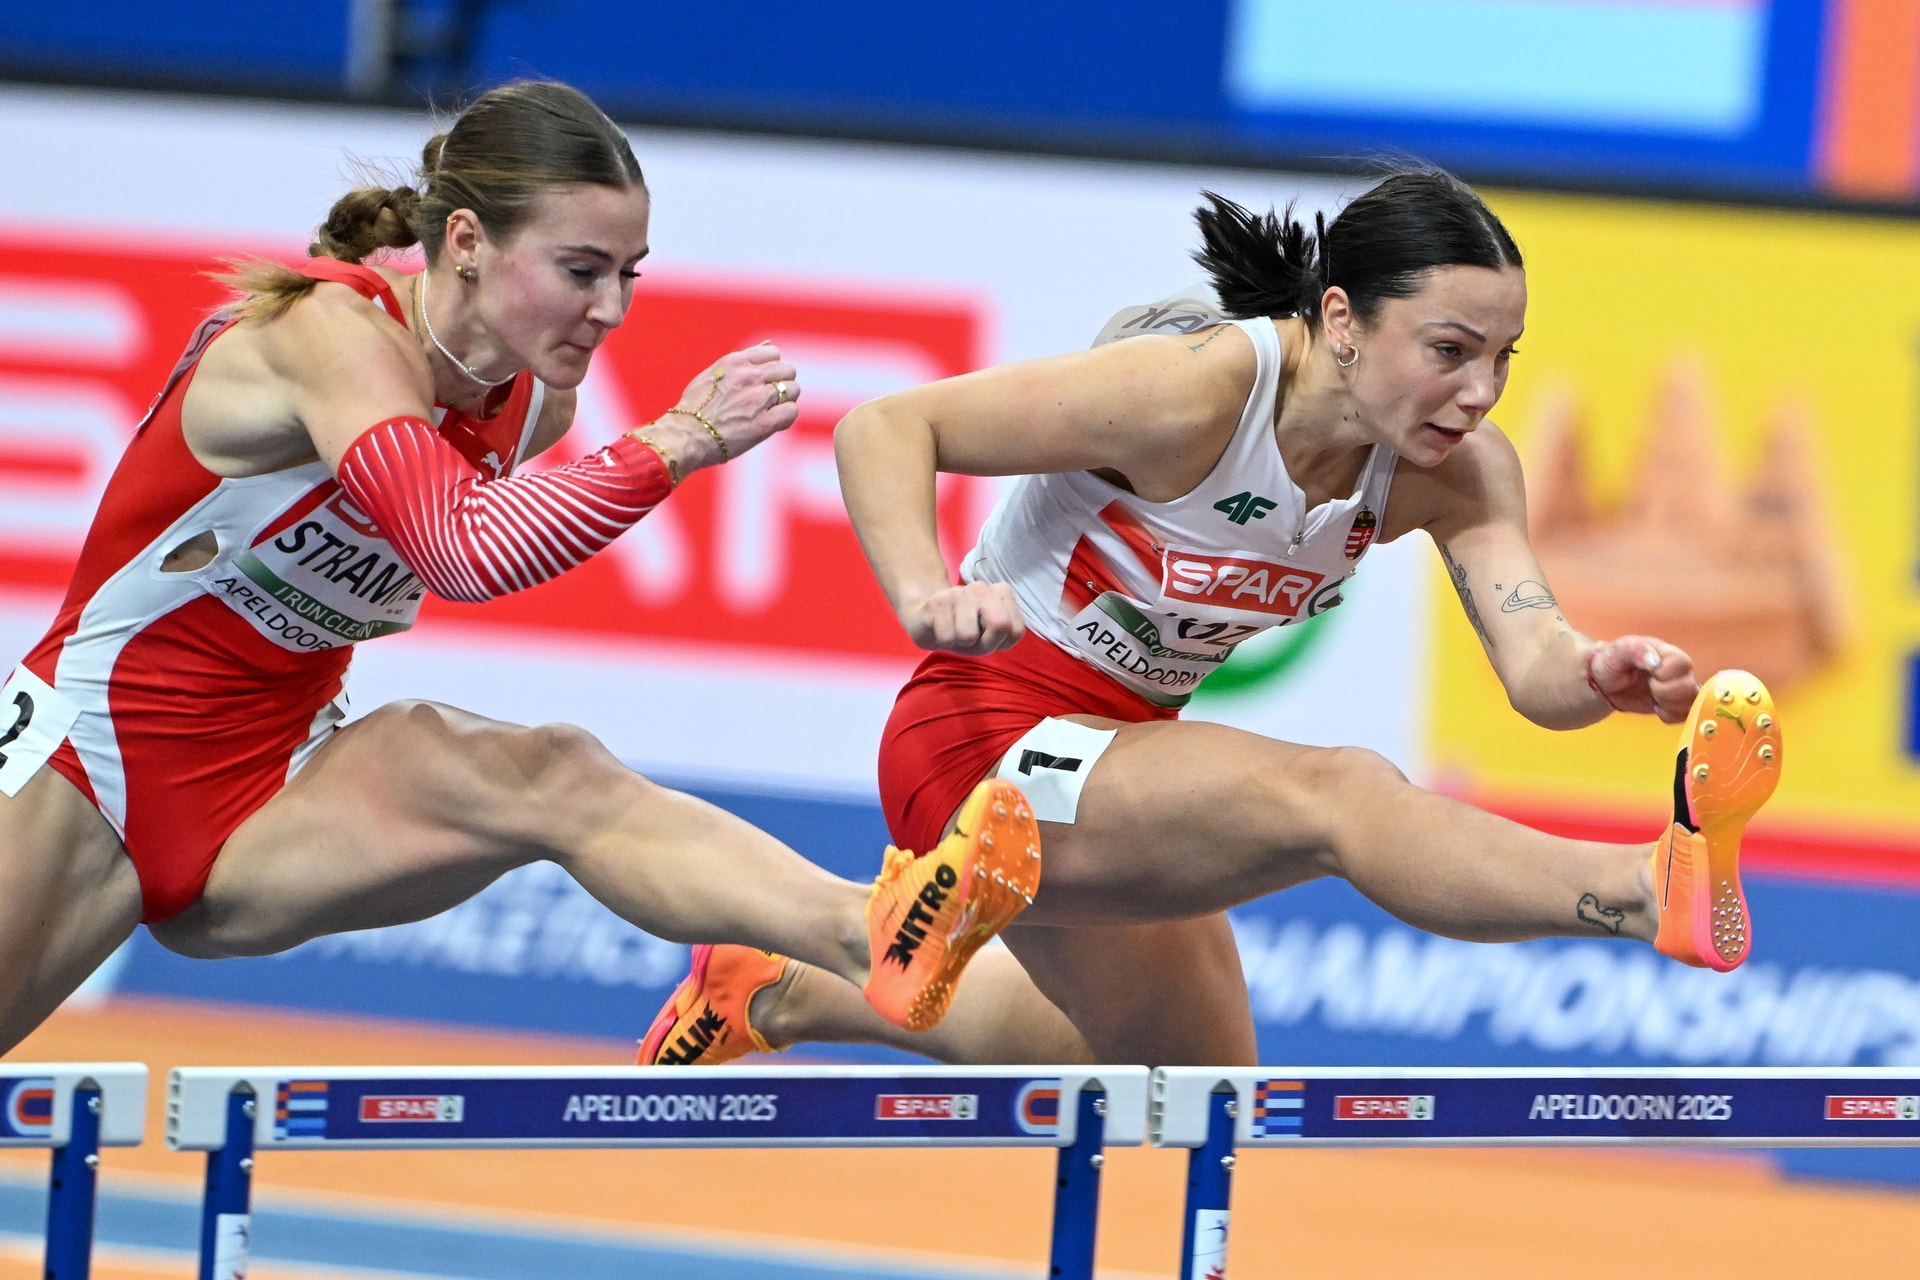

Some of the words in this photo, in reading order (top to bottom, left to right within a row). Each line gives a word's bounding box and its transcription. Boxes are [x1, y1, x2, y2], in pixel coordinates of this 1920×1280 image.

[1213, 491, 1278, 526] 4F
[1172, 559, 1314, 608] SPAR
[1018, 749, 1082, 776] 1
[881, 863, 958, 973] NITRO
[377, 1100, 440, 1117] SPAR
[562, 1094, 717, 1122] APELDOORN
[718, 1094, 779, 1121] 2025
[893, 1099, 953, 1115] SPAR
[1351, 1099, 1410, 1116] SPAR
[1528, 1094, 1676, 1121] APELDOORN
[1676, 1095, 1734, 1121] 2025
[1841, 1100, 1898, 1115] SPAR
